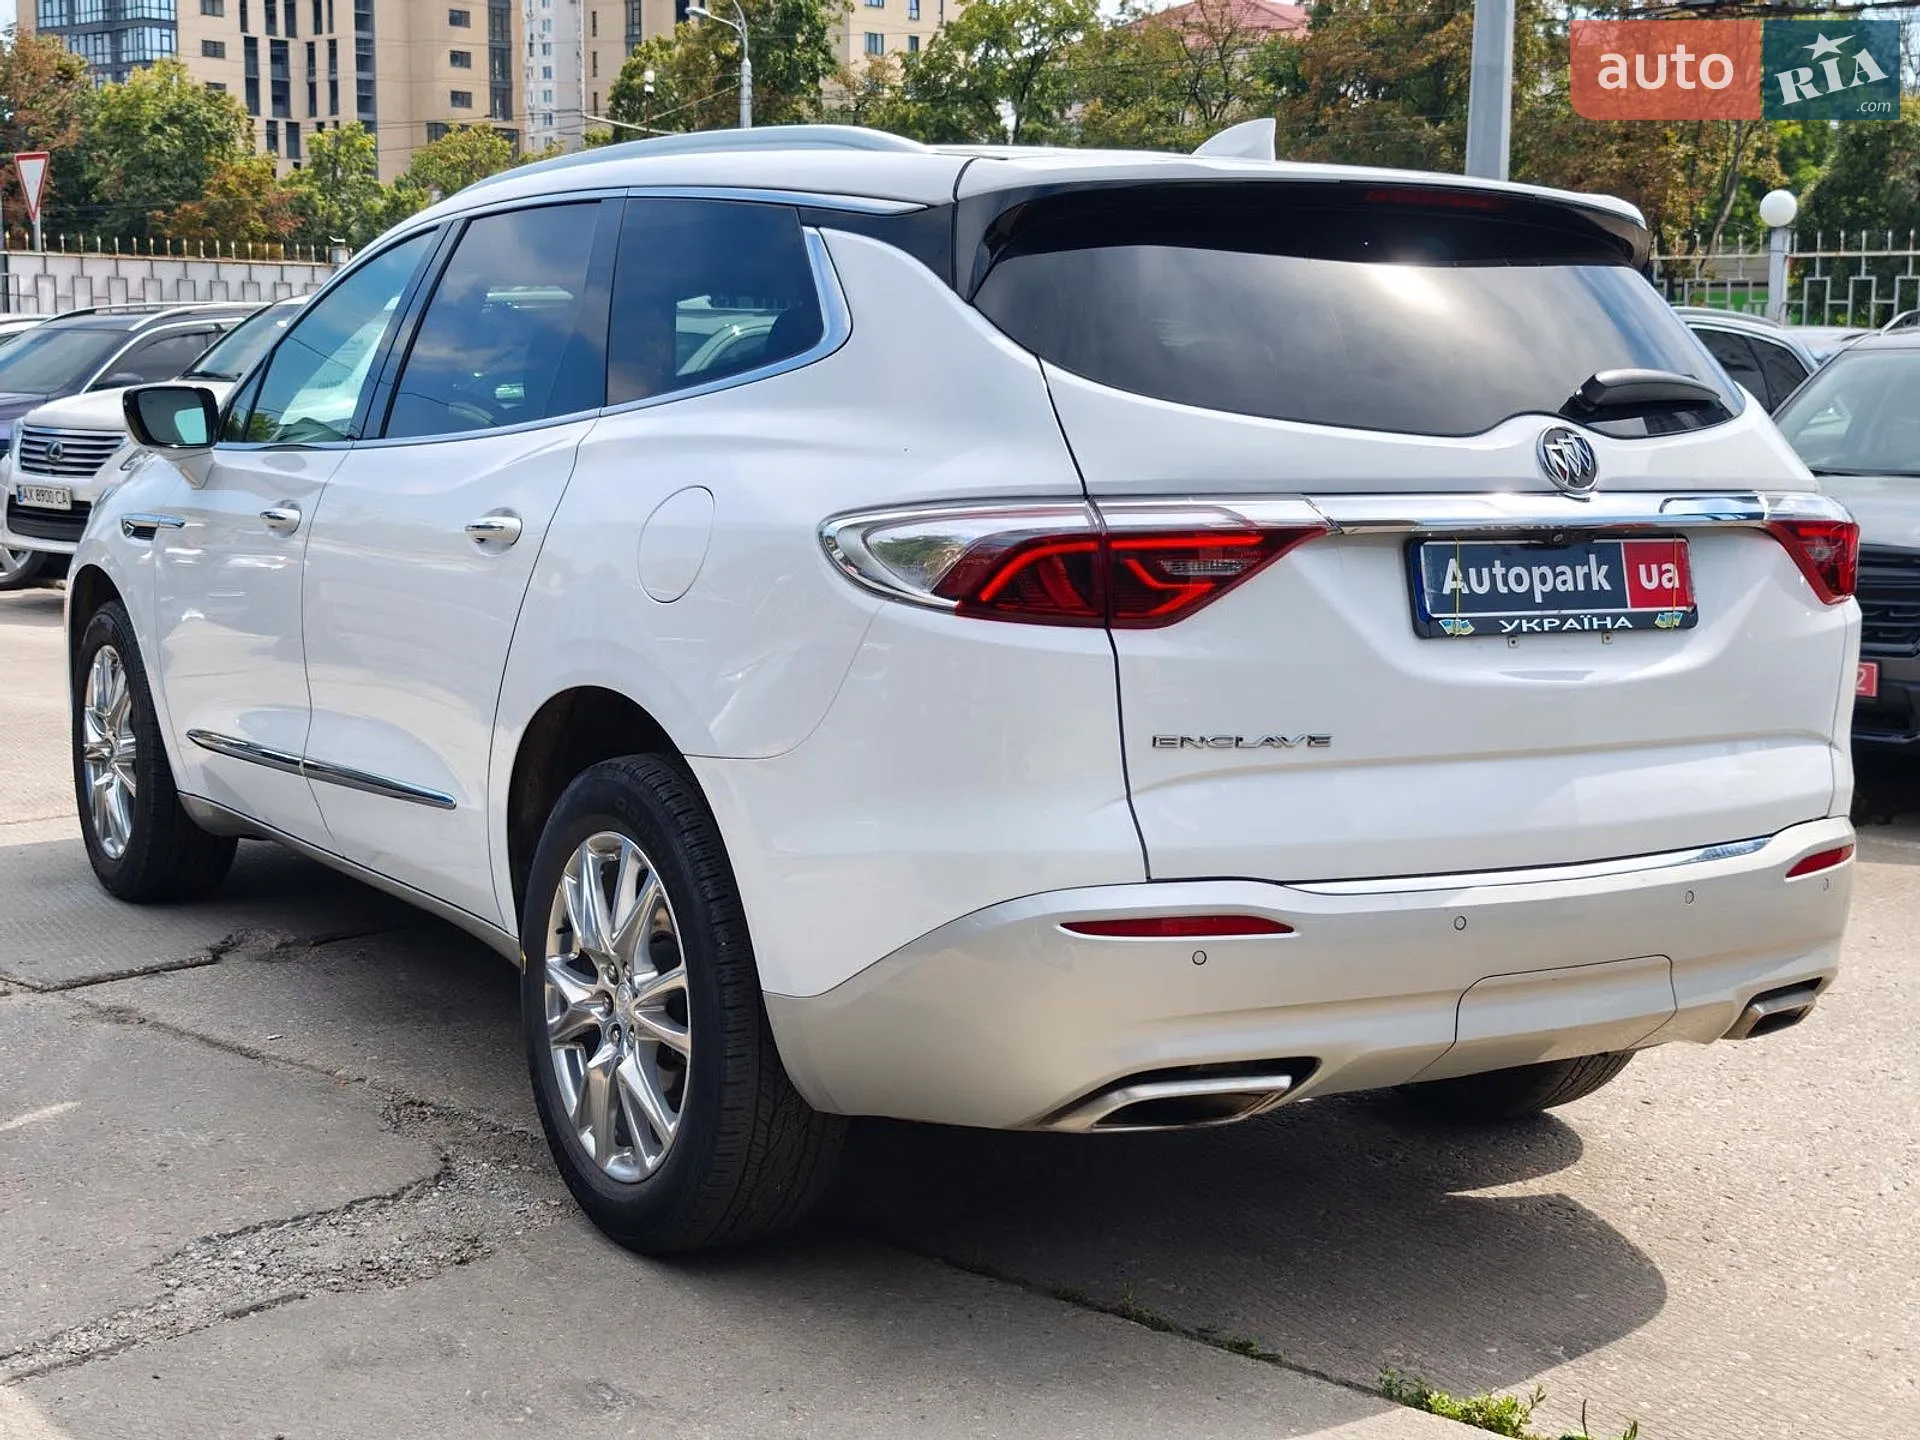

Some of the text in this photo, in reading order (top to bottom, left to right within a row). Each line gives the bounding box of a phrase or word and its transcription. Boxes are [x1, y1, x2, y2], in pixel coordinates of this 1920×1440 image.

[1442, 553, 1680, 603] Autopark ua
[1498, 614, 1633, 633] УКРАЇНА
[1151, 733, 1333, 749] ENCLAVE
